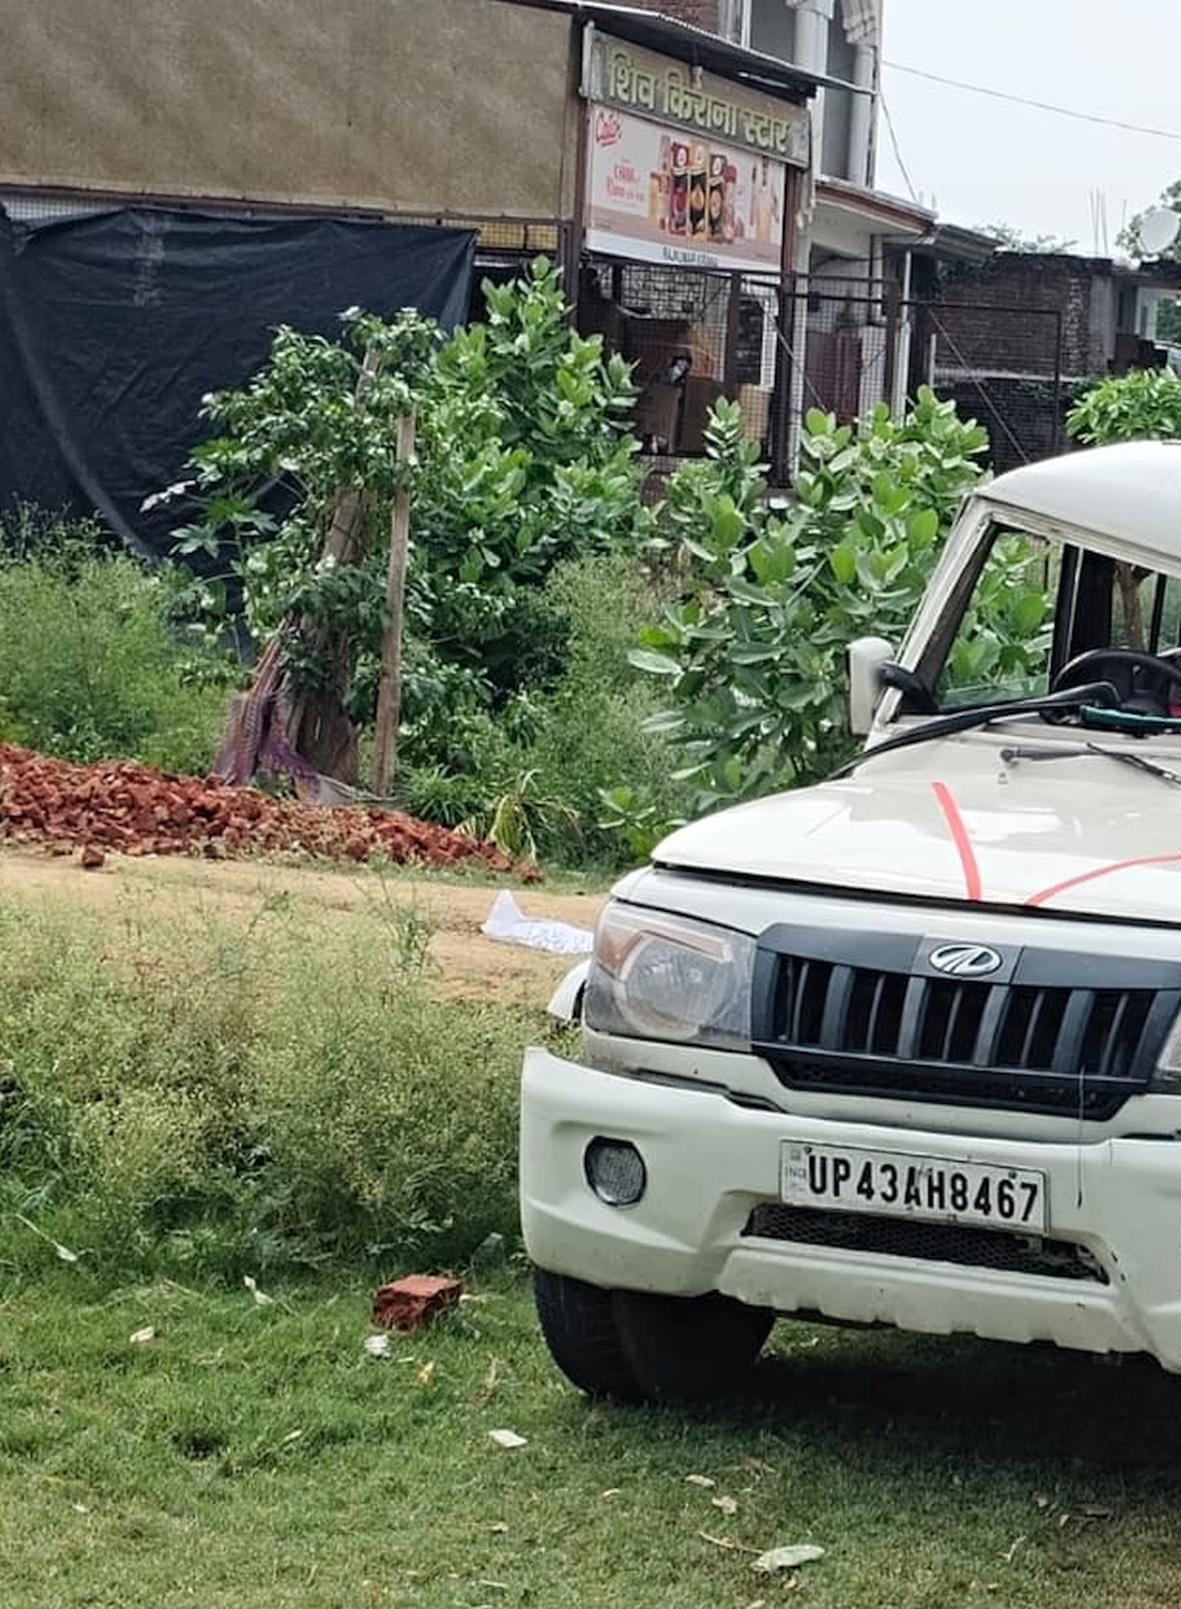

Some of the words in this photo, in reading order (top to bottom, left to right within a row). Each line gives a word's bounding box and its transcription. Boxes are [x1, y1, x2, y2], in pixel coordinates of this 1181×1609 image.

[609, 51, 656, 109] शिव
[661, 67, 737, 136] किराना
[808, 1155, 1039, 1222] UP43AH8467
